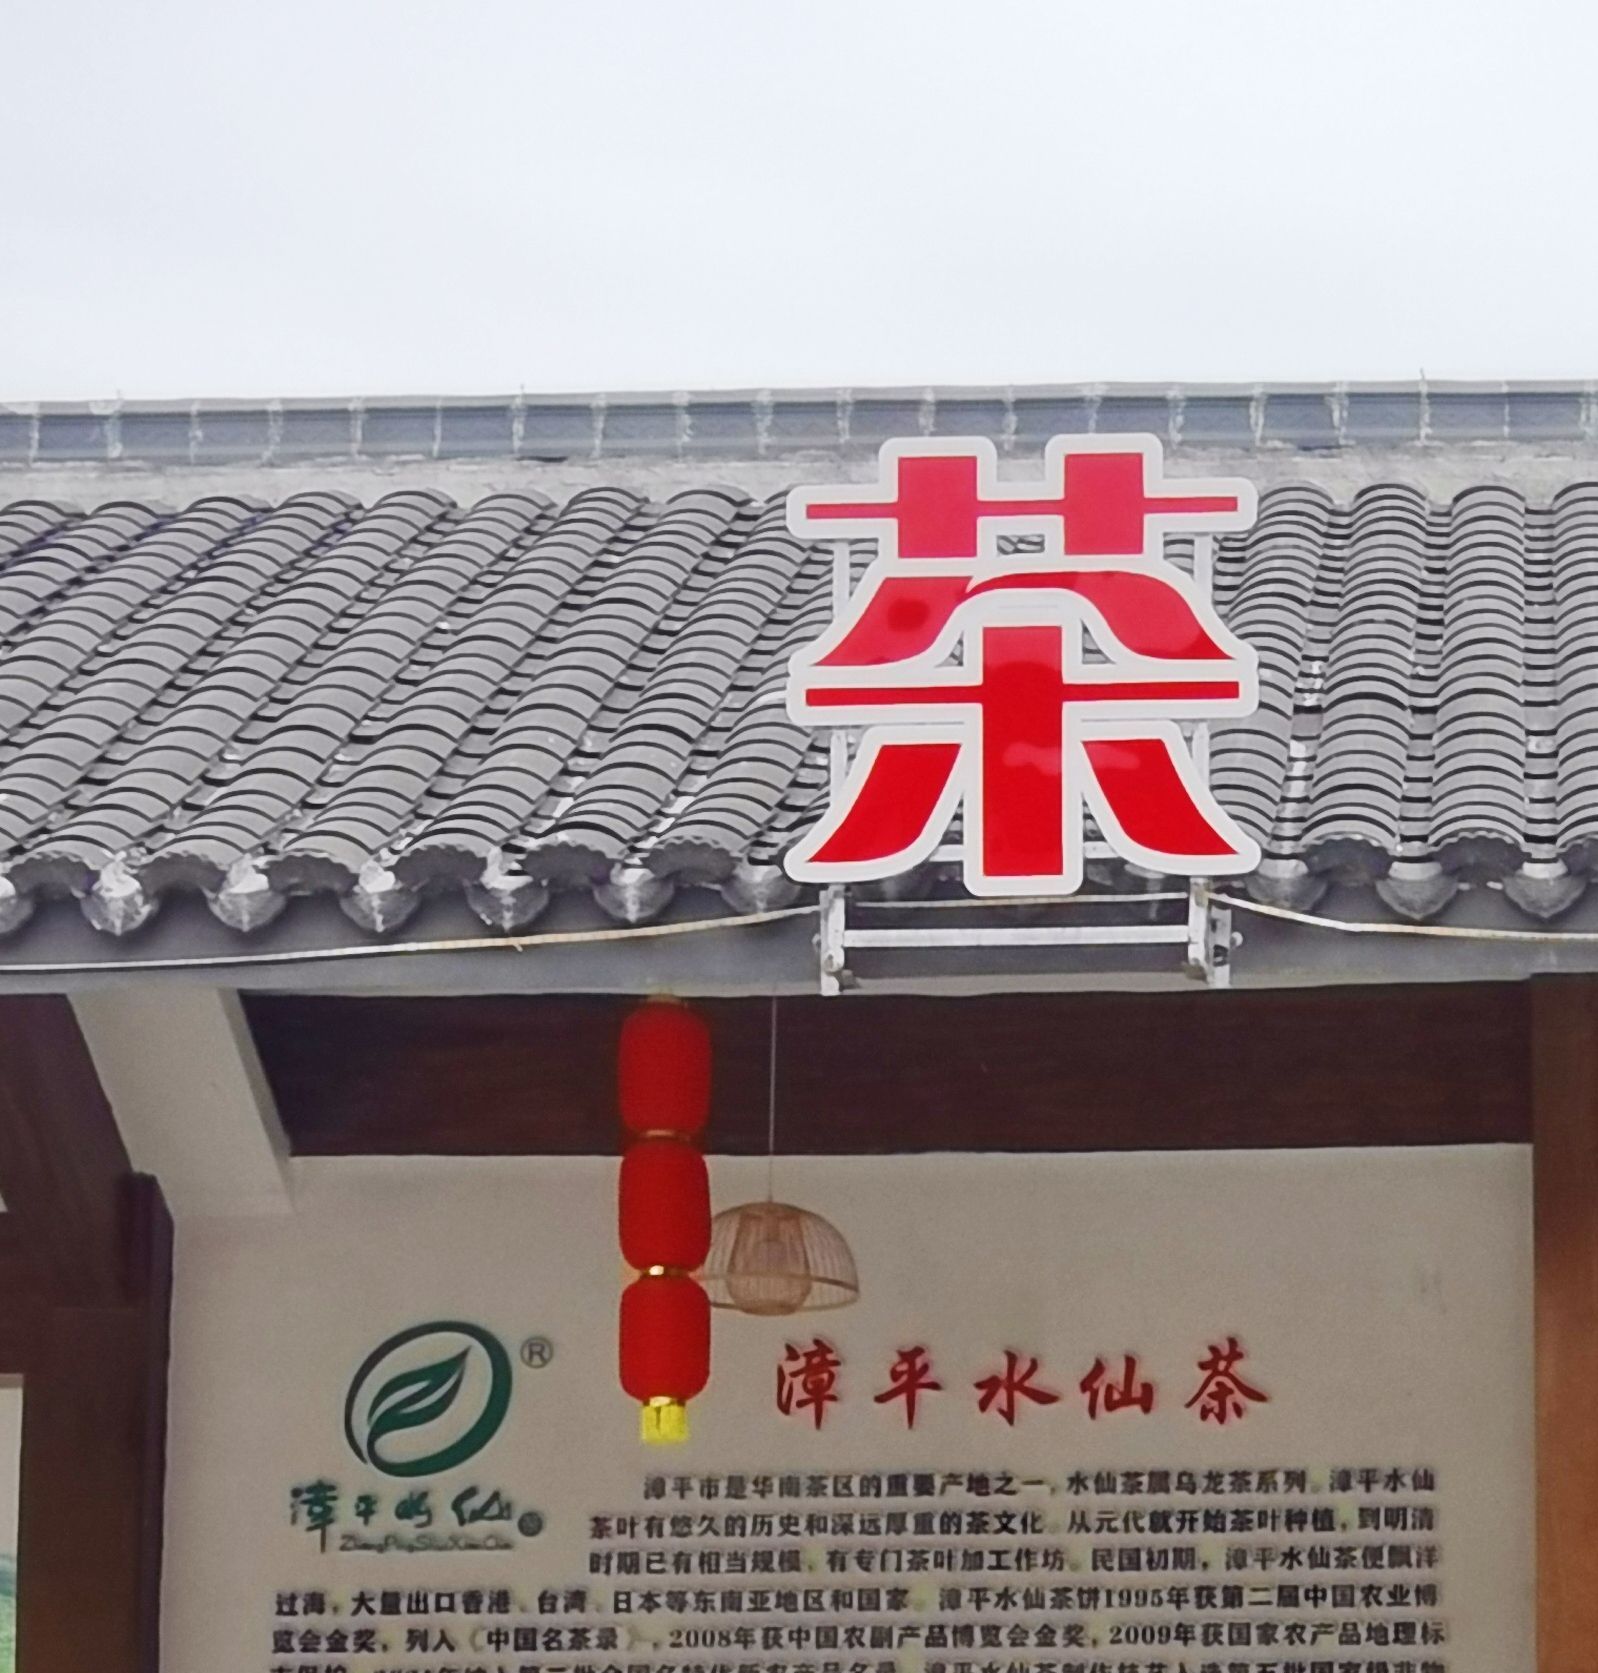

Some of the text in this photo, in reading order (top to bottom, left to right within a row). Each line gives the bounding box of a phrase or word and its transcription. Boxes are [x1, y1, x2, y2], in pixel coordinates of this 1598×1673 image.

[775, 1335, 1270, 1430] 漳平水仙茶
